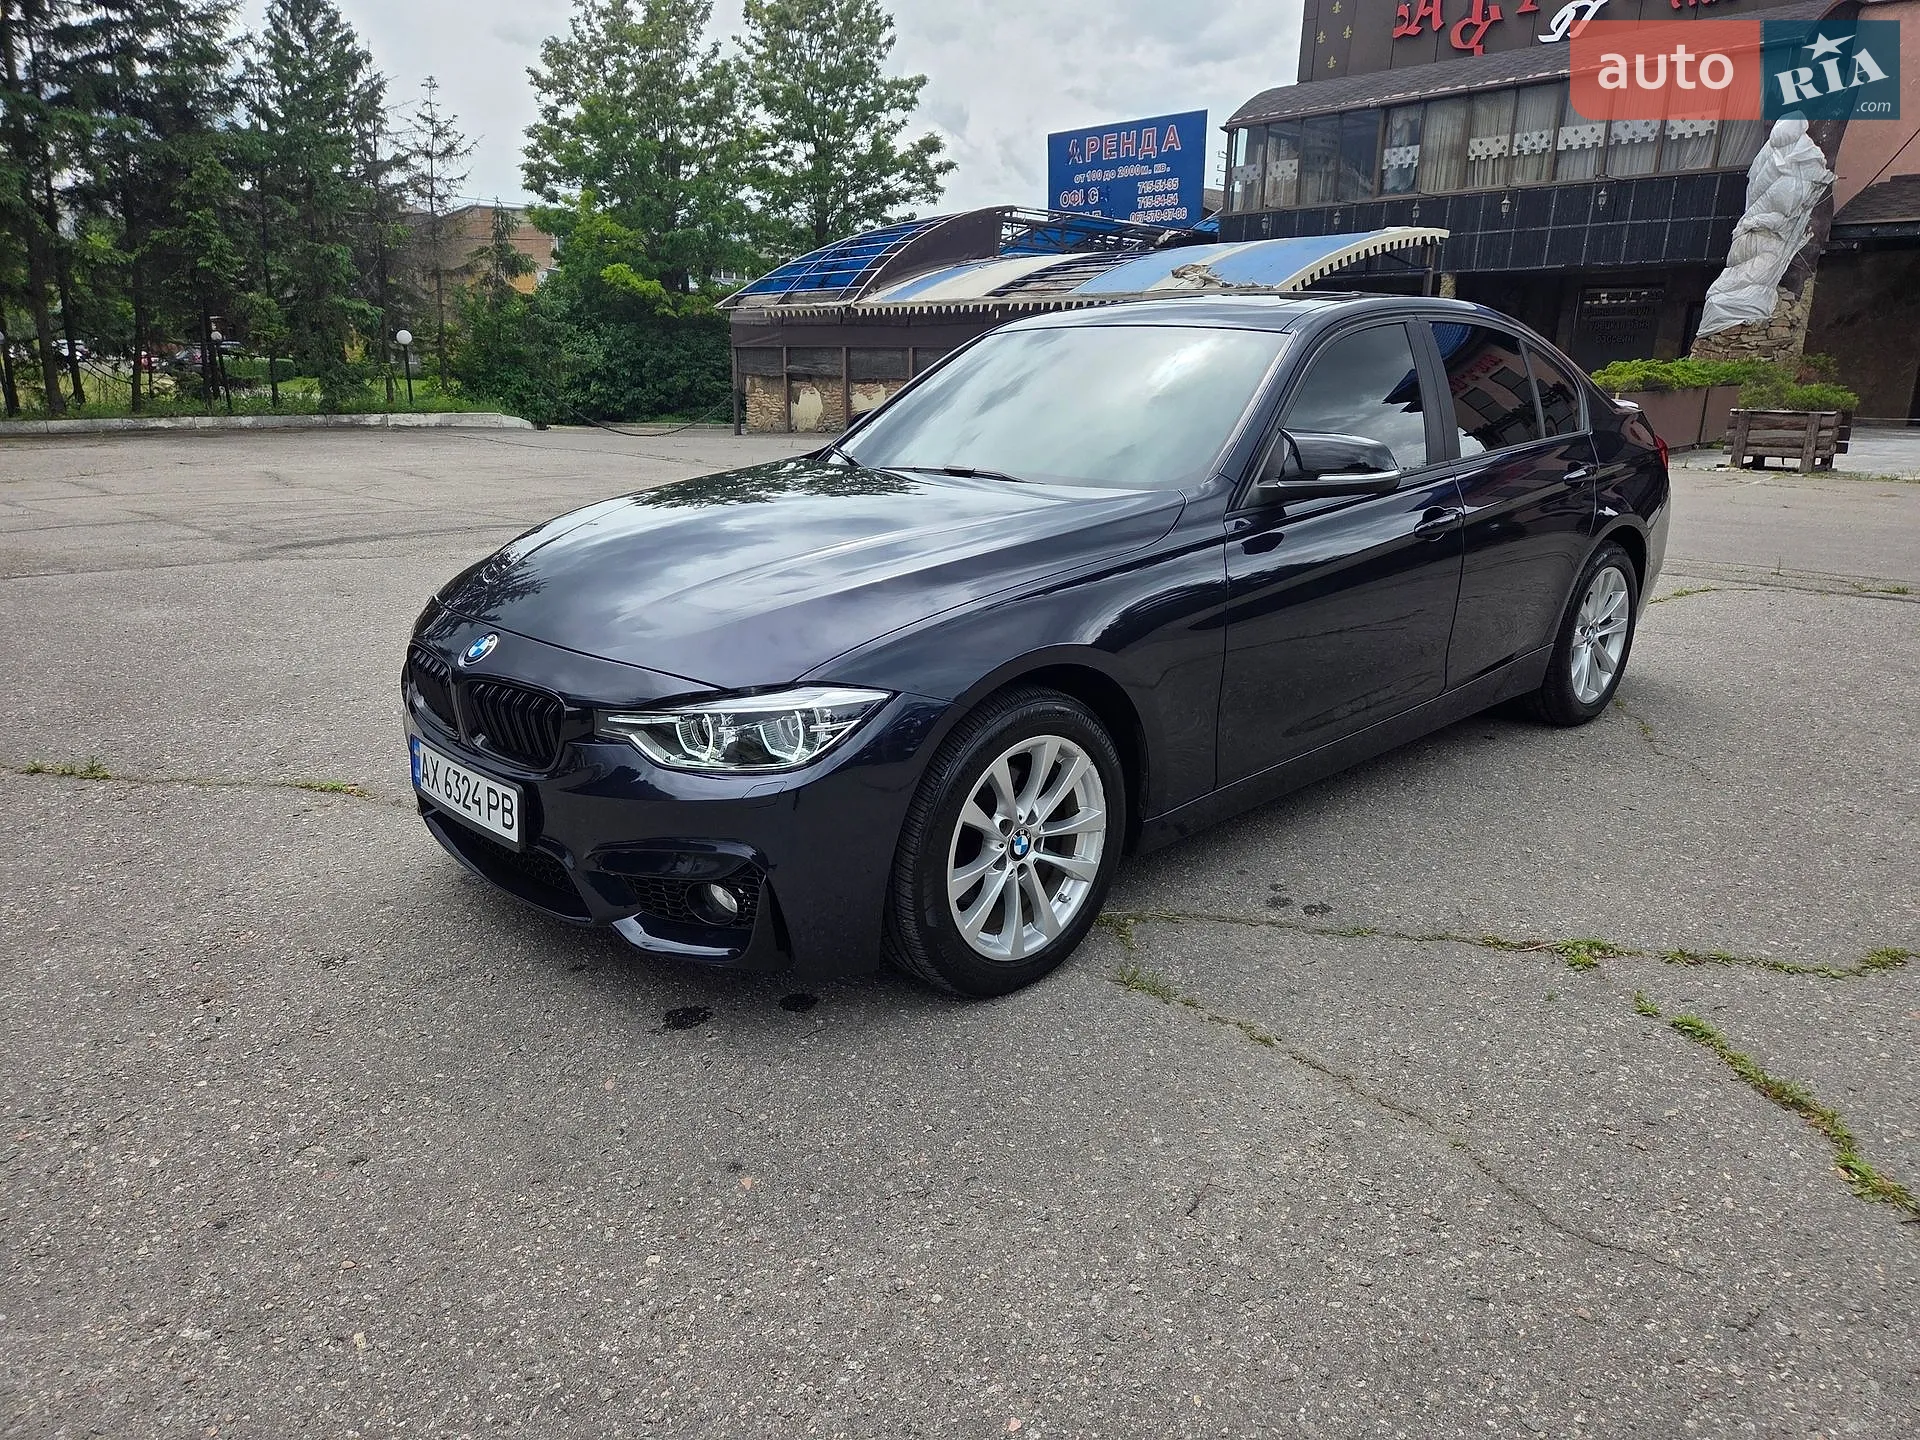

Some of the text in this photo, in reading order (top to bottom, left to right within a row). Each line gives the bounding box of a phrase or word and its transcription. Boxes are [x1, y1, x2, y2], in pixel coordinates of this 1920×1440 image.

[1068, 124, 1182, 165] АРЕНДА
[421, 752, 515, 831] AX 6324 PB
